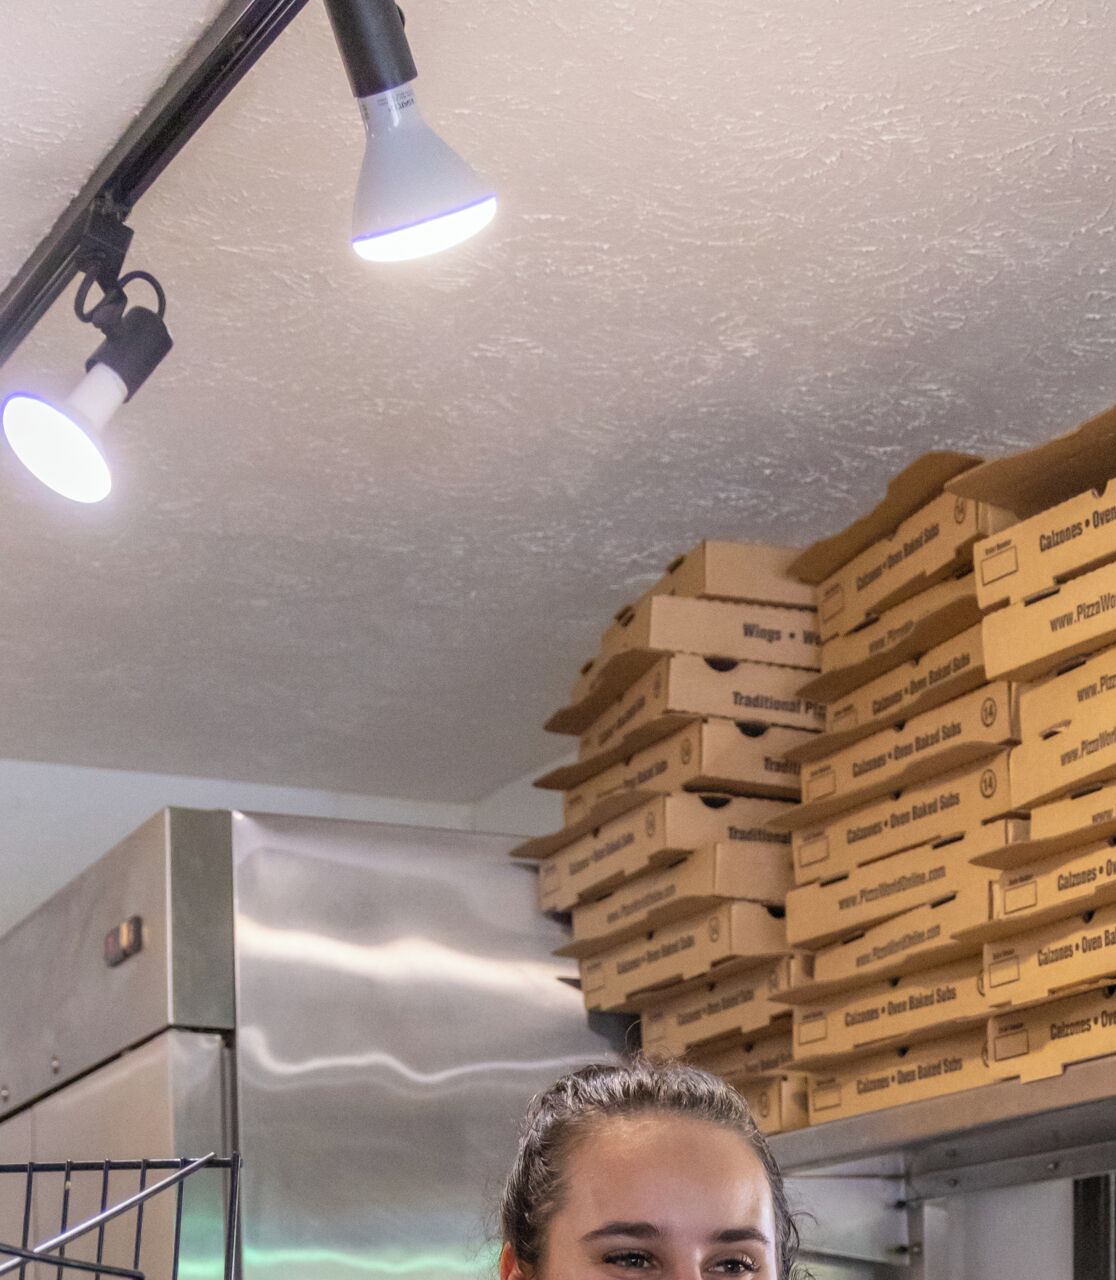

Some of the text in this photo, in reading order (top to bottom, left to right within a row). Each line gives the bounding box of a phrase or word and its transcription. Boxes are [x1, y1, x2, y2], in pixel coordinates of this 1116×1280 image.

[1039, 518, 1083, 552] Calzones
[1092, 506, 1116, 529] Oven
[742, 622, 782, 643] Wings
[1057, 865, 1097, 891] Calzones
[1036, 943, 1074, 967] Calzones
[1081, 934, 1102, 954] Oven
[935, 985, 957, 1002] Subs
[1050, 1017, 1092, 1041] Calzones
